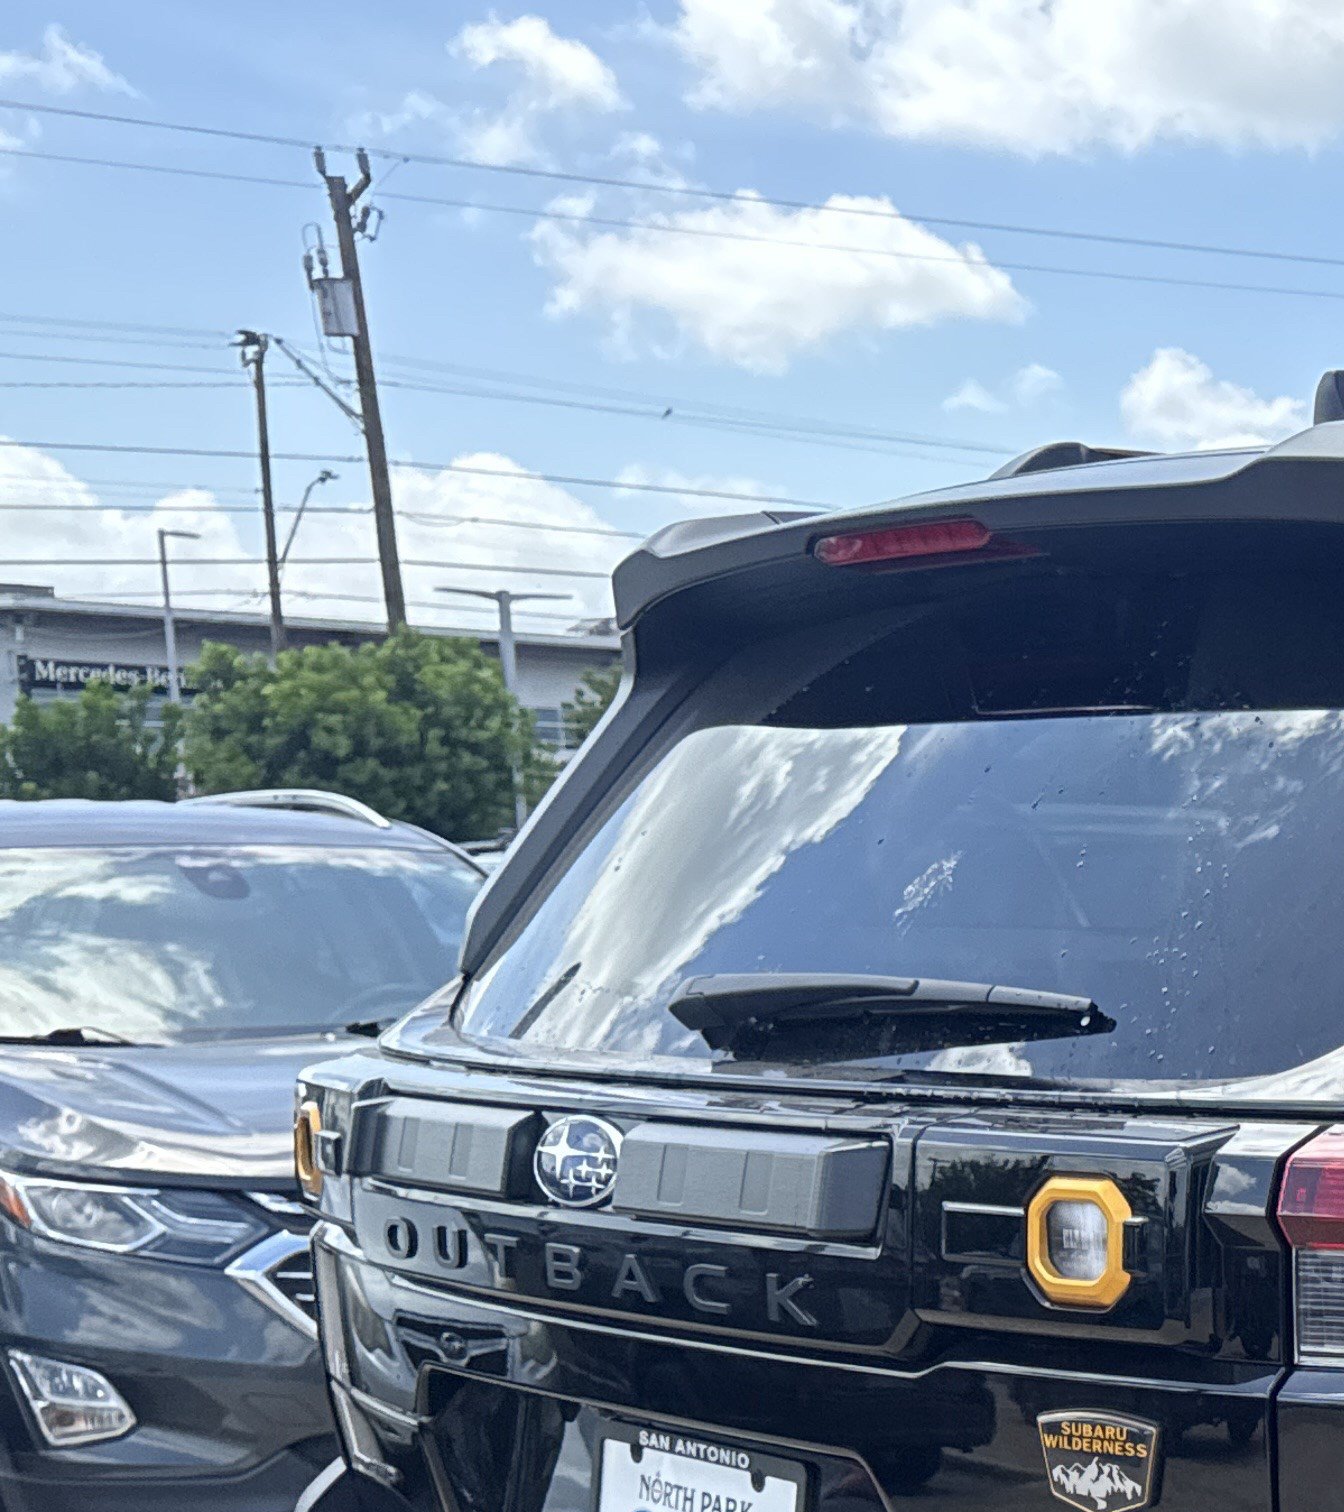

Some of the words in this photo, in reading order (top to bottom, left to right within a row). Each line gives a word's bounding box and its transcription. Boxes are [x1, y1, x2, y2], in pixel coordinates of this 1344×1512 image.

[382, 1216, 820, 1327] OUTBACK
[1043, 1433, 1148, 1458] WILDERNESS
[1061, 1421, 1128, 1441] SUBARU
[638, 1430, 670, 1451] SAN
[674, 1438, 750, 1469] ANTONIO
